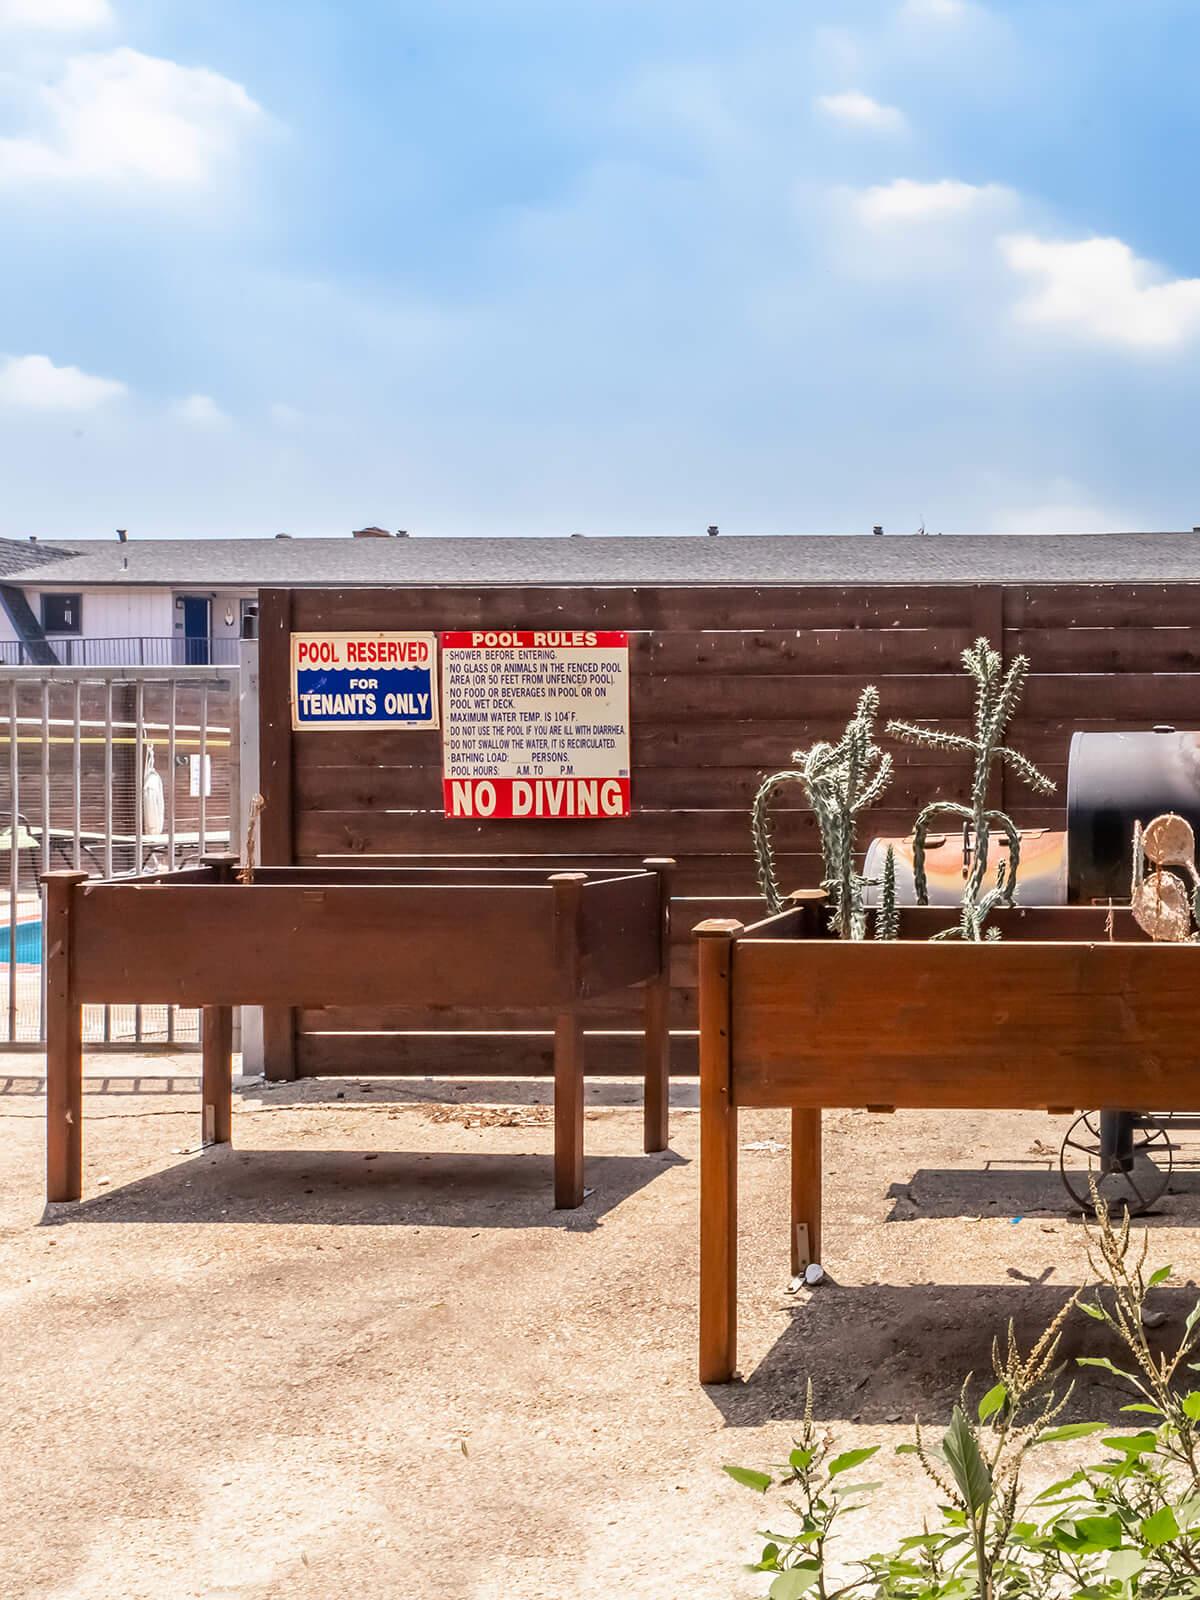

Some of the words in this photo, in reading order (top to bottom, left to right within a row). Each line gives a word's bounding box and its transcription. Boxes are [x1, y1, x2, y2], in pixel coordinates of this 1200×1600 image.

[472, 633, 523, 646] POOL
[534, 632, 598, 646] RULES
[298, 642, 339, 663] POOL
[347, 641, 428, 662] RESERVED
[450, 651, 481, 660] SHOWER
[486, 651, 514, 660] BEFORE
[519, 650, 557, 659] ENTERING.
[450, 664, 461, 673] NO
[464, 664, 488, 673] GLASS
[491, 664, 501, 673] OR
[504, 664, 537, 673] ANIMALS
[540, 664, 548, 672] IN
[550, 663, 564, 672] THE
[568, 663, 598, 672] FENCED
[601, 663, 621, 672] POOL
[350, 679, 378, 689] FOR
[450, 675, 470, 684] AREA
[473, 675, 486, 686] (OR
[489, 675, 498, 684] 50
[501, 675, 519, 684] FEET
[522, 674, 543, 684] FROM
[546, 674, 587, 683] UNFENCED
[590, 674, 614, 685] POOL).
[450, 688, 461, 697] NO
[464, 688, 485, 697] FOOD
[488, 688, 499, 697] OR
[501, 688, 545, 697] BEVERAGES
[548, 688, 556, 697] IN
[558, 688, 578, 697] POOL
[582, 687, 592, 697] OR
[595, 687, 606, 696] ON
[300, 694, 376, 715] TENANTS
[384, 693, 428, 715] ONLY
[450, 699, 471, 709] POOL
[474, 699, 491, 709] WET
[493, 699, 514, 708] DECK.
[450, 713, 488, 722] MAXIMUM
[491, 712, 517, 722] WATER
[519, 712, 542, 722] TEMP.
[545, 712, 551, 721] IS
[451, 727, 460, 736] DO
[462, 727, 476, 736] NOT
[479, 727, 490, 735] USE
[492, 726, 504, 735] THE
[506, 726, 524, 735] POOL
[526, 726, 532, 735] IF
[534, 726, 547, 735] YOU
[550, 726, 562, 735] ARE
[564, 726, 573, 735] ILL
[575, 726, 591, 735] WITH
[451, 740, 460, 749] DO
[463, 740, 476, 749] NOT
[479, 740, 510, 749] SWALLOW
[512, 740, 524, 749] THE
[551, 740, 557, 749] IT
[559, 740, 565, 748] IS
[567, 739, 616, 748] RECIRCULATED.
[451, 754, 484, 763] BATHING
[487, 753, 509, 762] LOAD:
[532, 753, 570, 762] PERSONS.
[451, 767, 471, 776] POOL
[473, 767, 500, 776] HOURS:
[517, 766, 531, 775] A.M.
[534, 766, 543, 775] TO
[560, 766, 575, 775] P.M.
[452, 781, 496, 816] NO
[512, 780, 623, 816] DIVING
